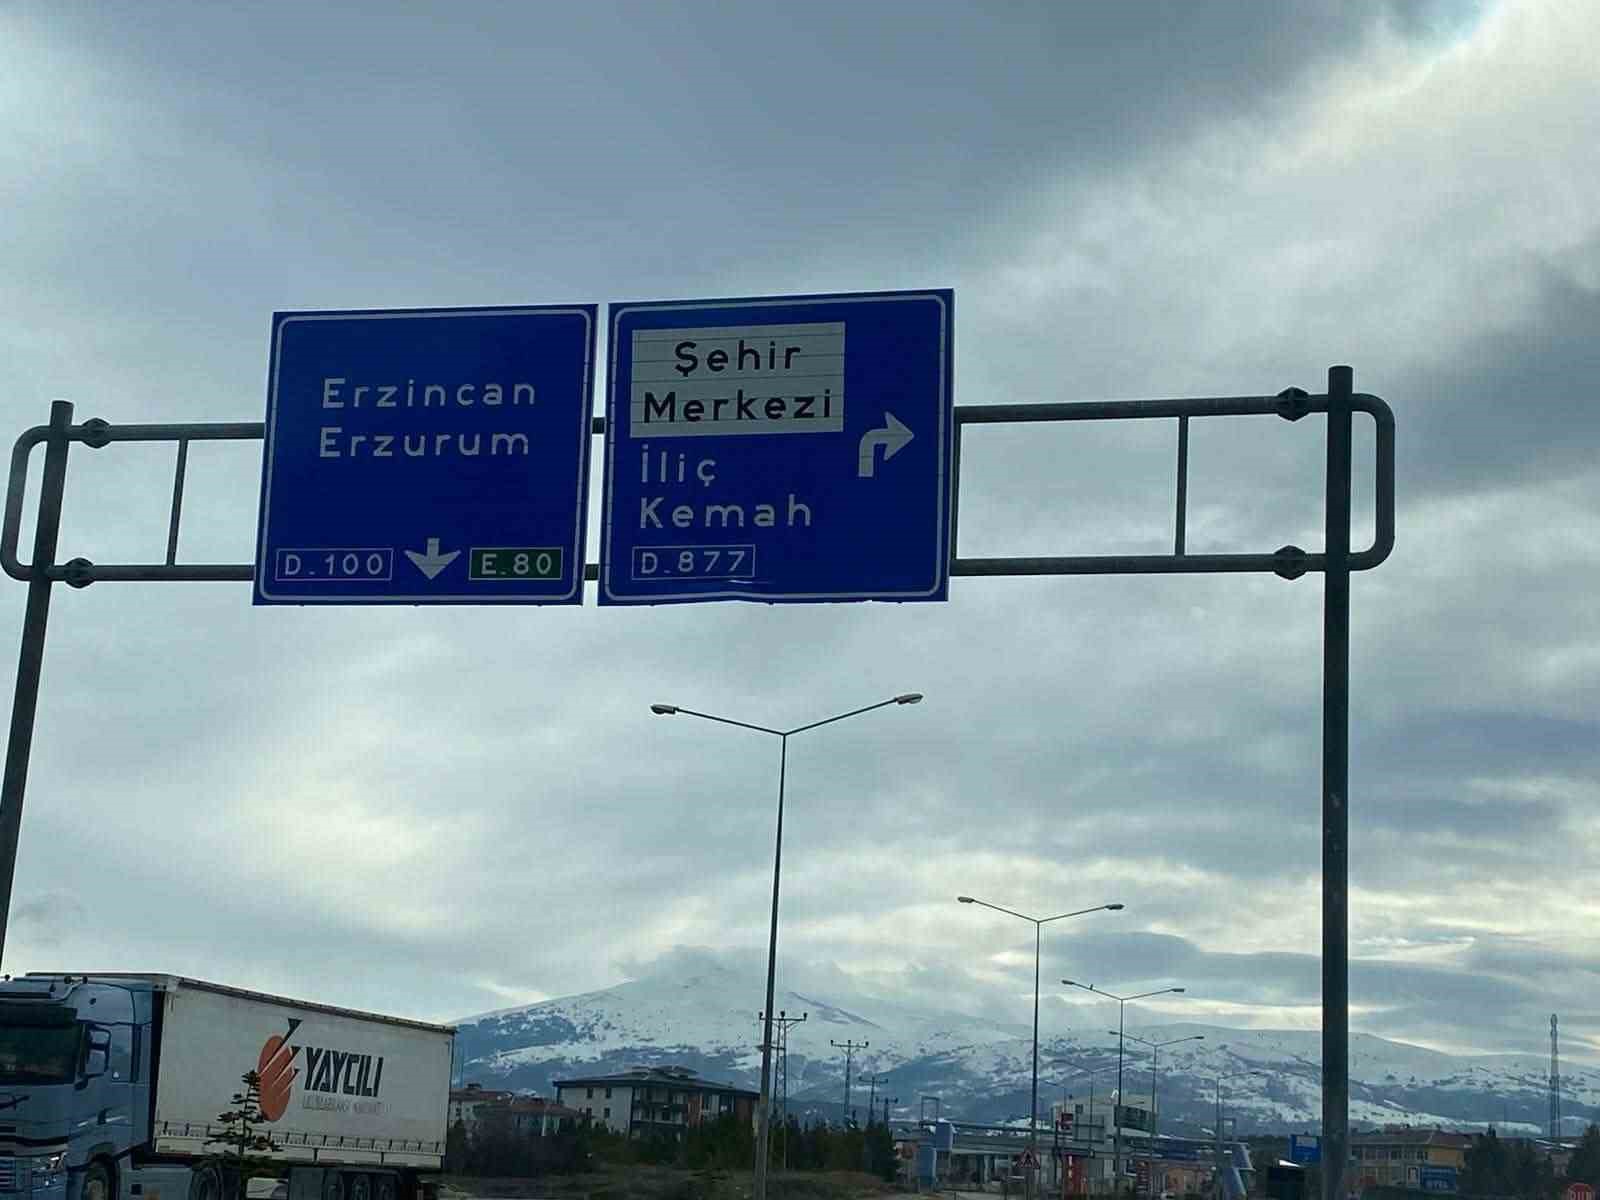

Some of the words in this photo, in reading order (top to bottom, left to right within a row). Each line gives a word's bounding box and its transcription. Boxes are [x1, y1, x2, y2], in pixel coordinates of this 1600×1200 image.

[675, 339, 801, 377] Şehir
[322, 378, 536, 409] Erzincan
[642, 389, 831, 424] Merkezi
[319, 426, 530, 458] Erzurum
[640, 443, 717, 487] İliç
[639, 493, 812, 529] Kemah
[284, 553, 384, 576] D.100
[480, 553, 553, 575] E.80
[641, 550, 746, 574] D.877
[304, 1046, 384, 1098] YAYCILI
